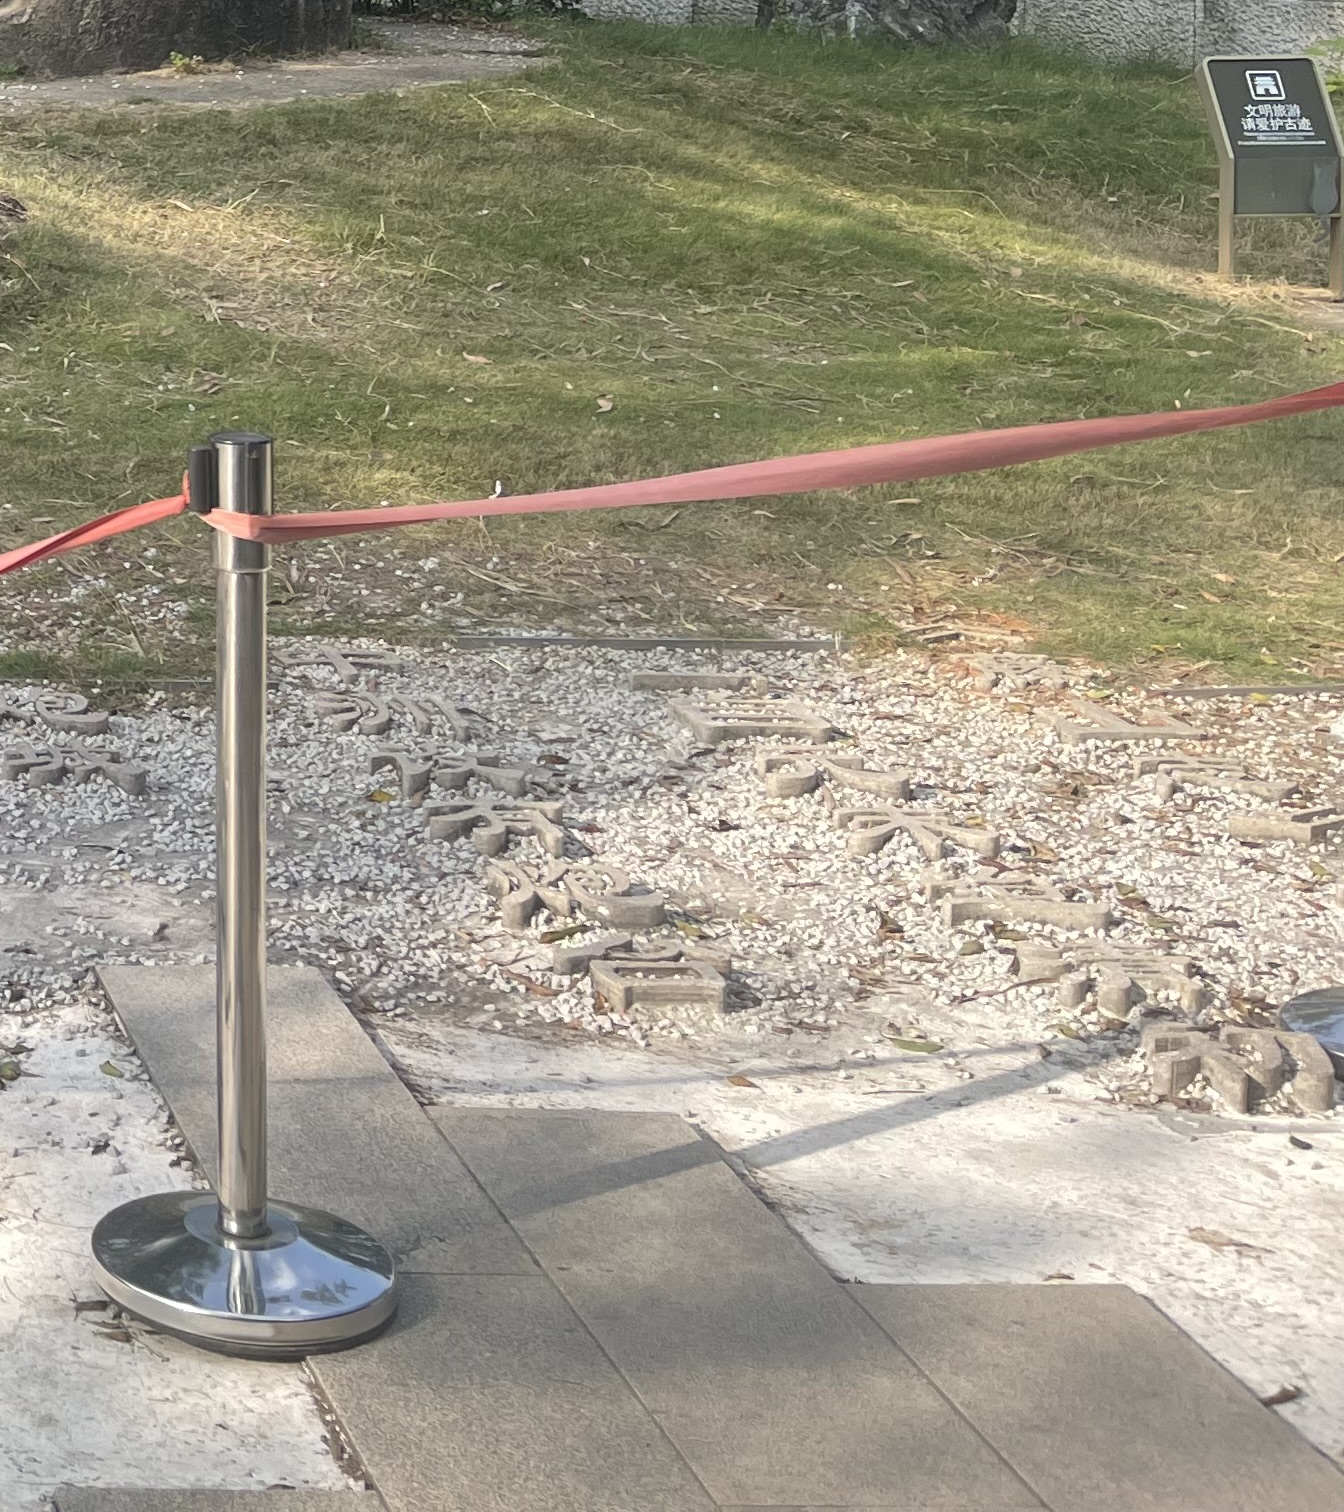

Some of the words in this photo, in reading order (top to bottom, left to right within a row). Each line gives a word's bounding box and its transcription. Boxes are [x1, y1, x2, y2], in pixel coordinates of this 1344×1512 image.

[1243, 103, 1301, 118] 文明旅游
[1241, 117, 1313, 131] 请爱护古迹
